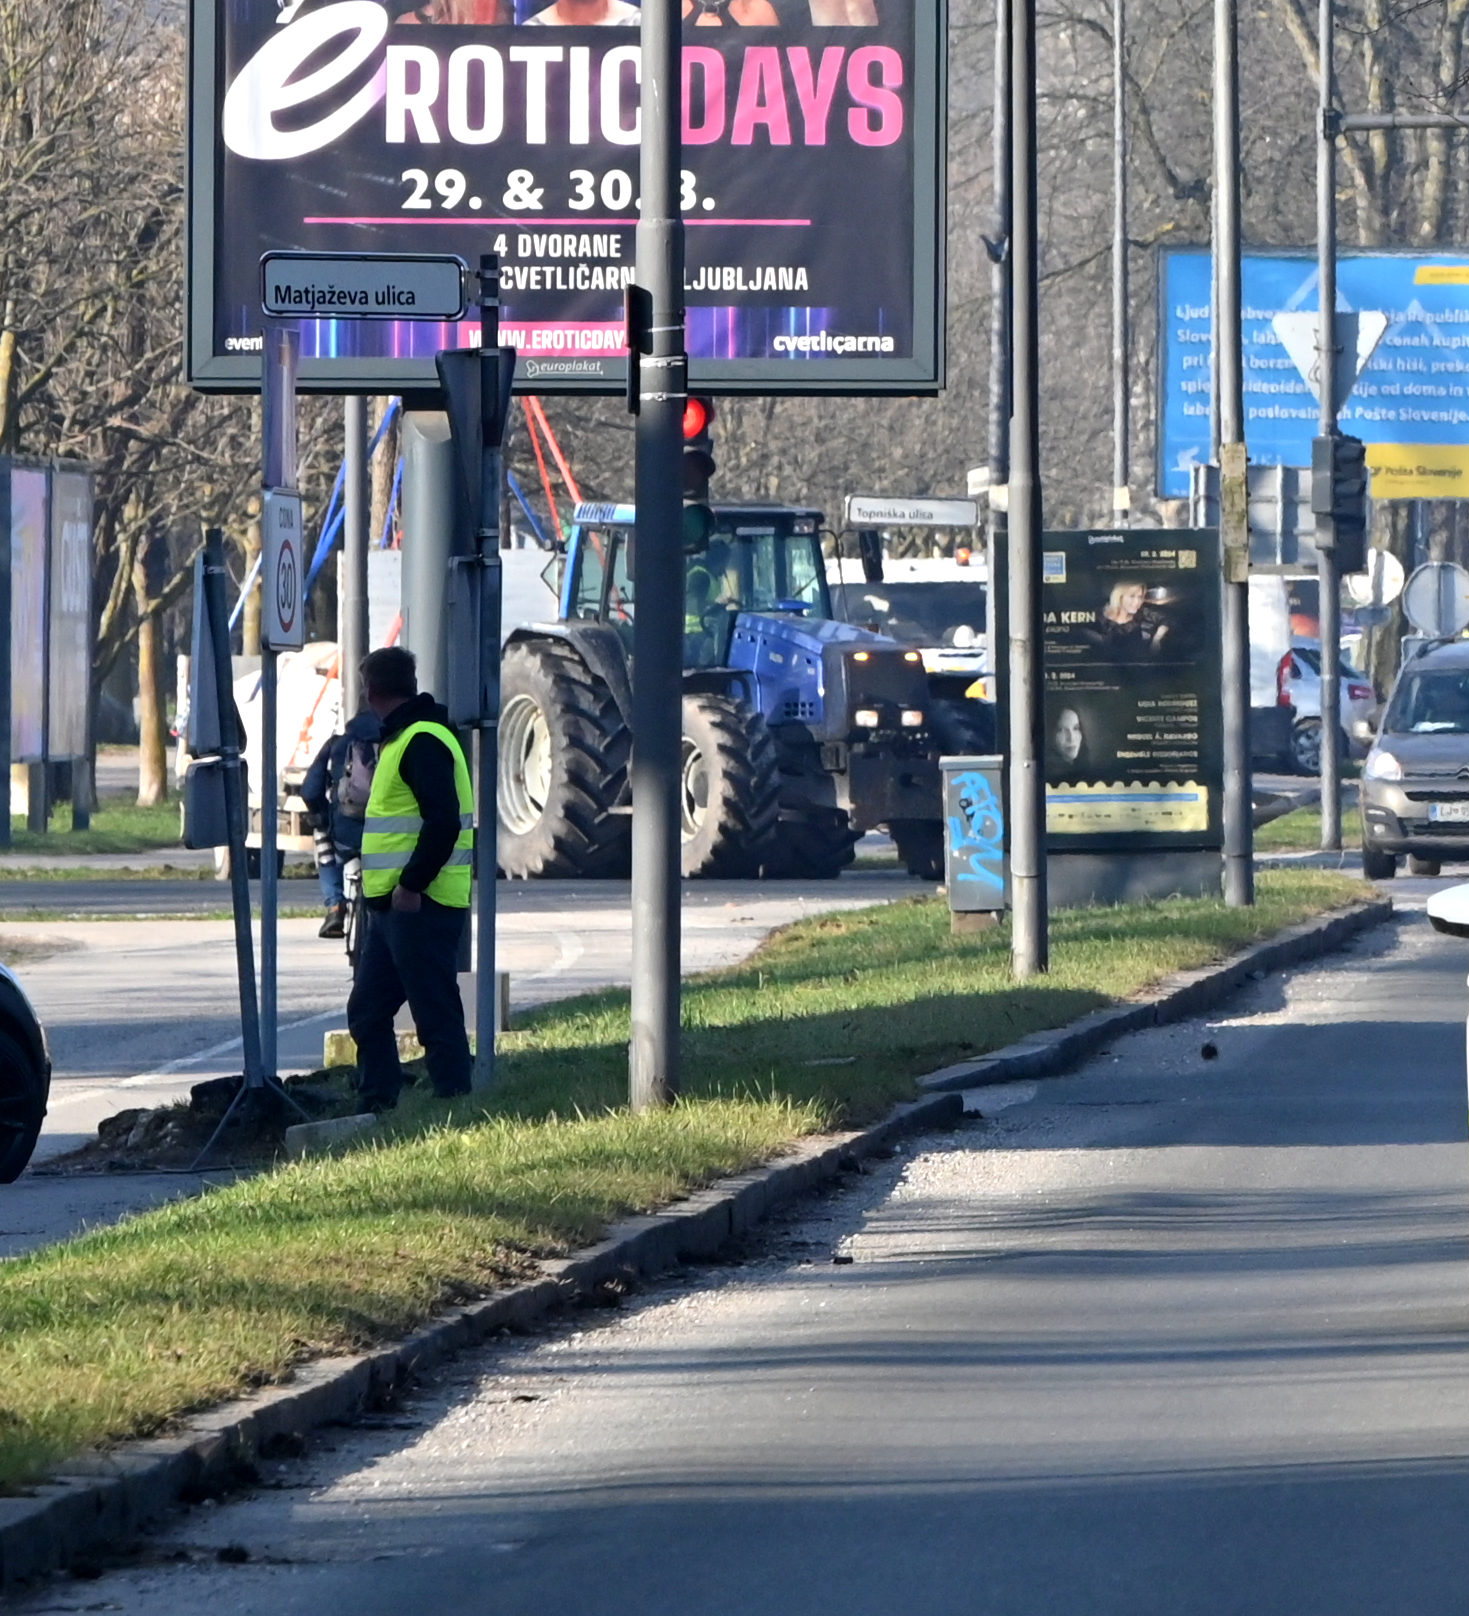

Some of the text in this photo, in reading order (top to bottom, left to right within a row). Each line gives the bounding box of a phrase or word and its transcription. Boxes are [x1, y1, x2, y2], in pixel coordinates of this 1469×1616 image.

[401, 169, 483, 210] 29.
[502, 169, 544, 210] &
[493, 234, 622, 258] 4 DVORANE
[500, 262, 809, 291] CVETLIČARN LJUBLJANA
[274, 284, 416, 310] Matjaževa ulica
[469, 329, 628, 351] WW.EROTICDAY
[540, 361, 601, 374] europlakat
[857, 507, 934, 520] Topniška ulica
[281, 562, 292, 609] 30
[1061, 611, 1096, 624] KERN
